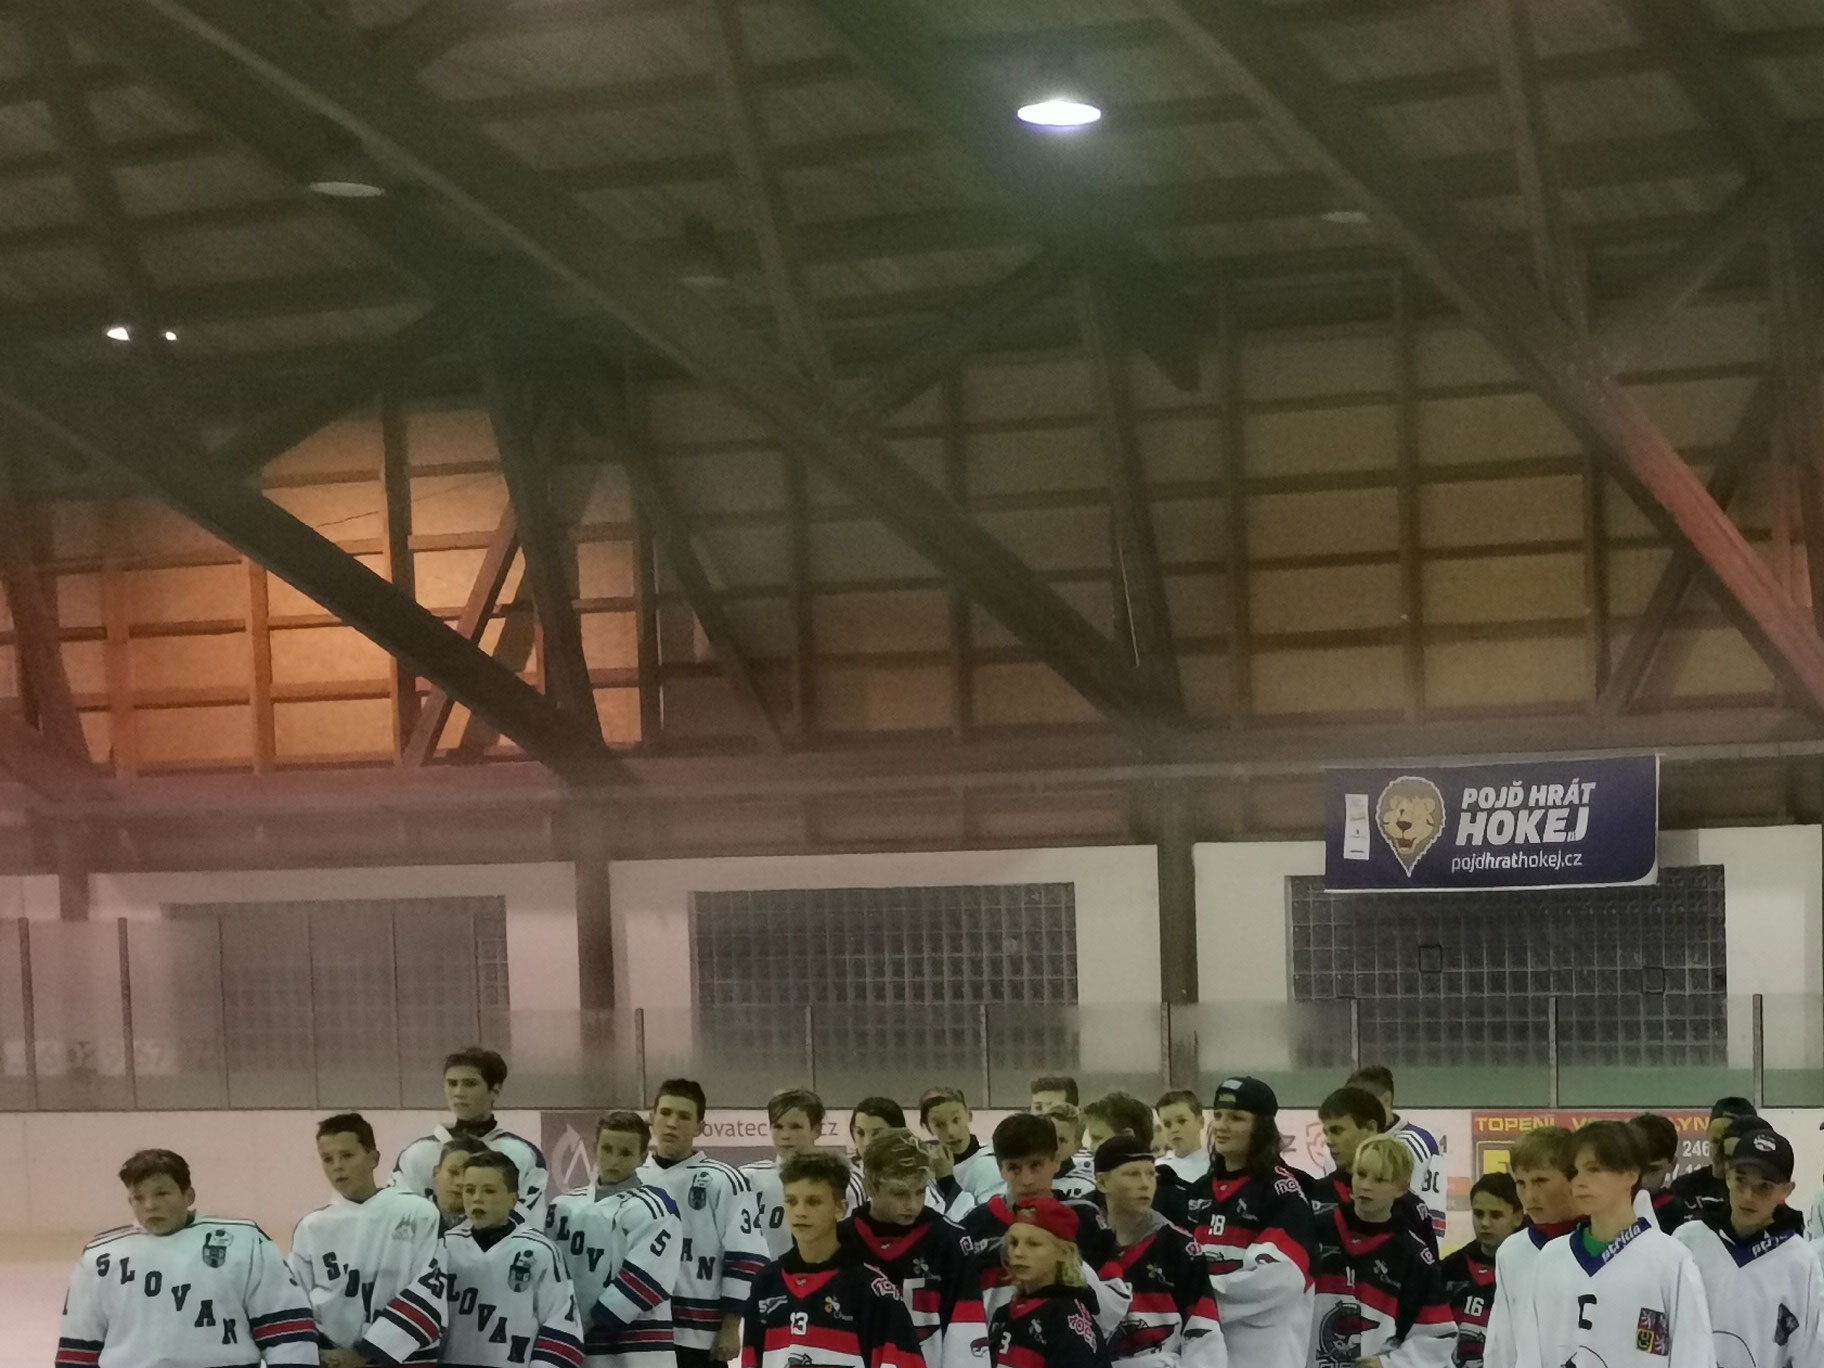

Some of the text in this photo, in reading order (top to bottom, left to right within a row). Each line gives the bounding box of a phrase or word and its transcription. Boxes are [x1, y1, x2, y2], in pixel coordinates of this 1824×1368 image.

[1461, 777, 1596, 809] POJĎ HRÁT
[1455, 807, 1589, 846] HOKEJ
[1451, 851, 1583, 873] pojdhrathokej.cz
[650, 1229, 671, 1257] 5
[96, 1253, 239, 1345] SLOVAN
[1463, 1295, 1485, 1317] 16
[789, 1312, 809, 1336] 13
